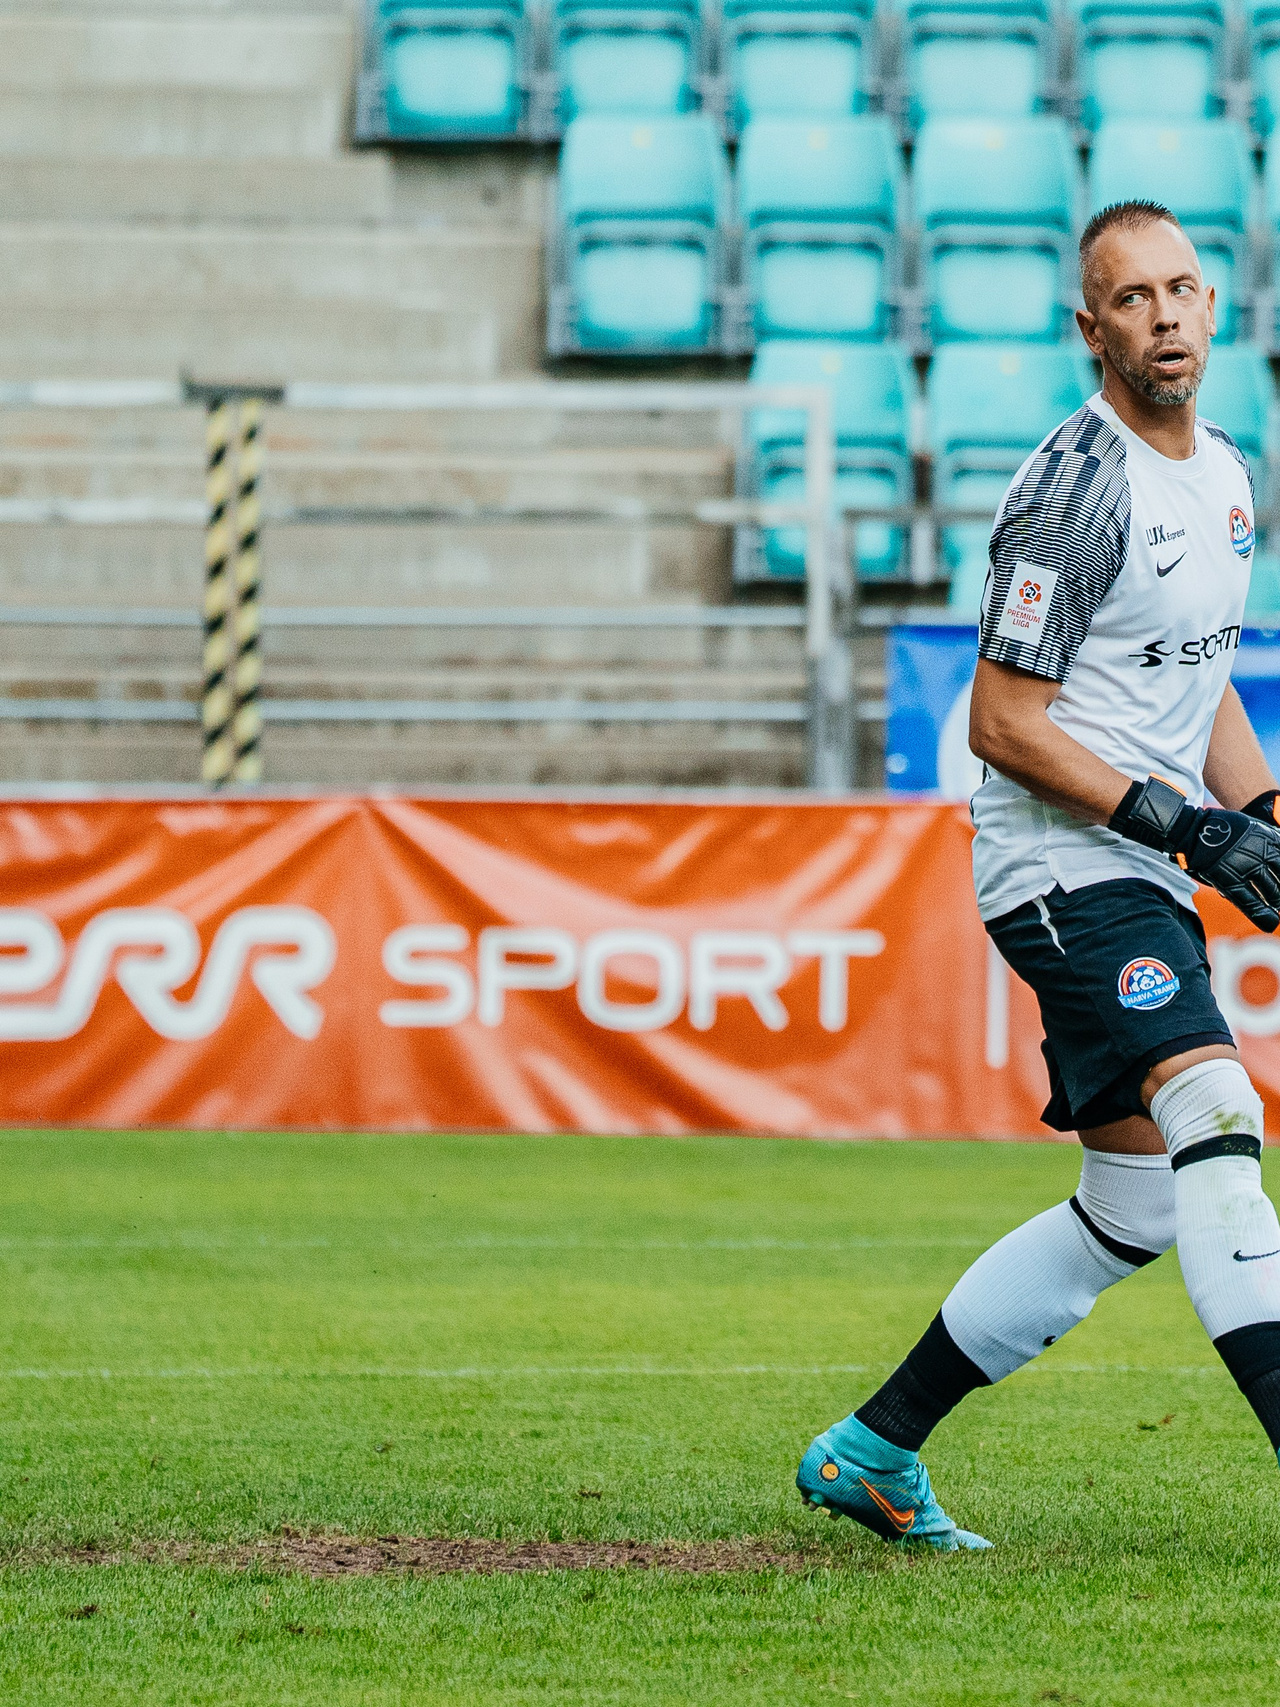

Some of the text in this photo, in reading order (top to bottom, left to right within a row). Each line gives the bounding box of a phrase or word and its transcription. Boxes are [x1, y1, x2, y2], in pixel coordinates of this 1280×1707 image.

[1007, 608, 1040, 624] PREMIUM
[1012, 618, 1030, 629] LIIGA
[380, 924, 885, 1033] SPORT
[1127, 991, 1153, 1004] NARVA
[1153, 983, 1174, 996] TRANS
